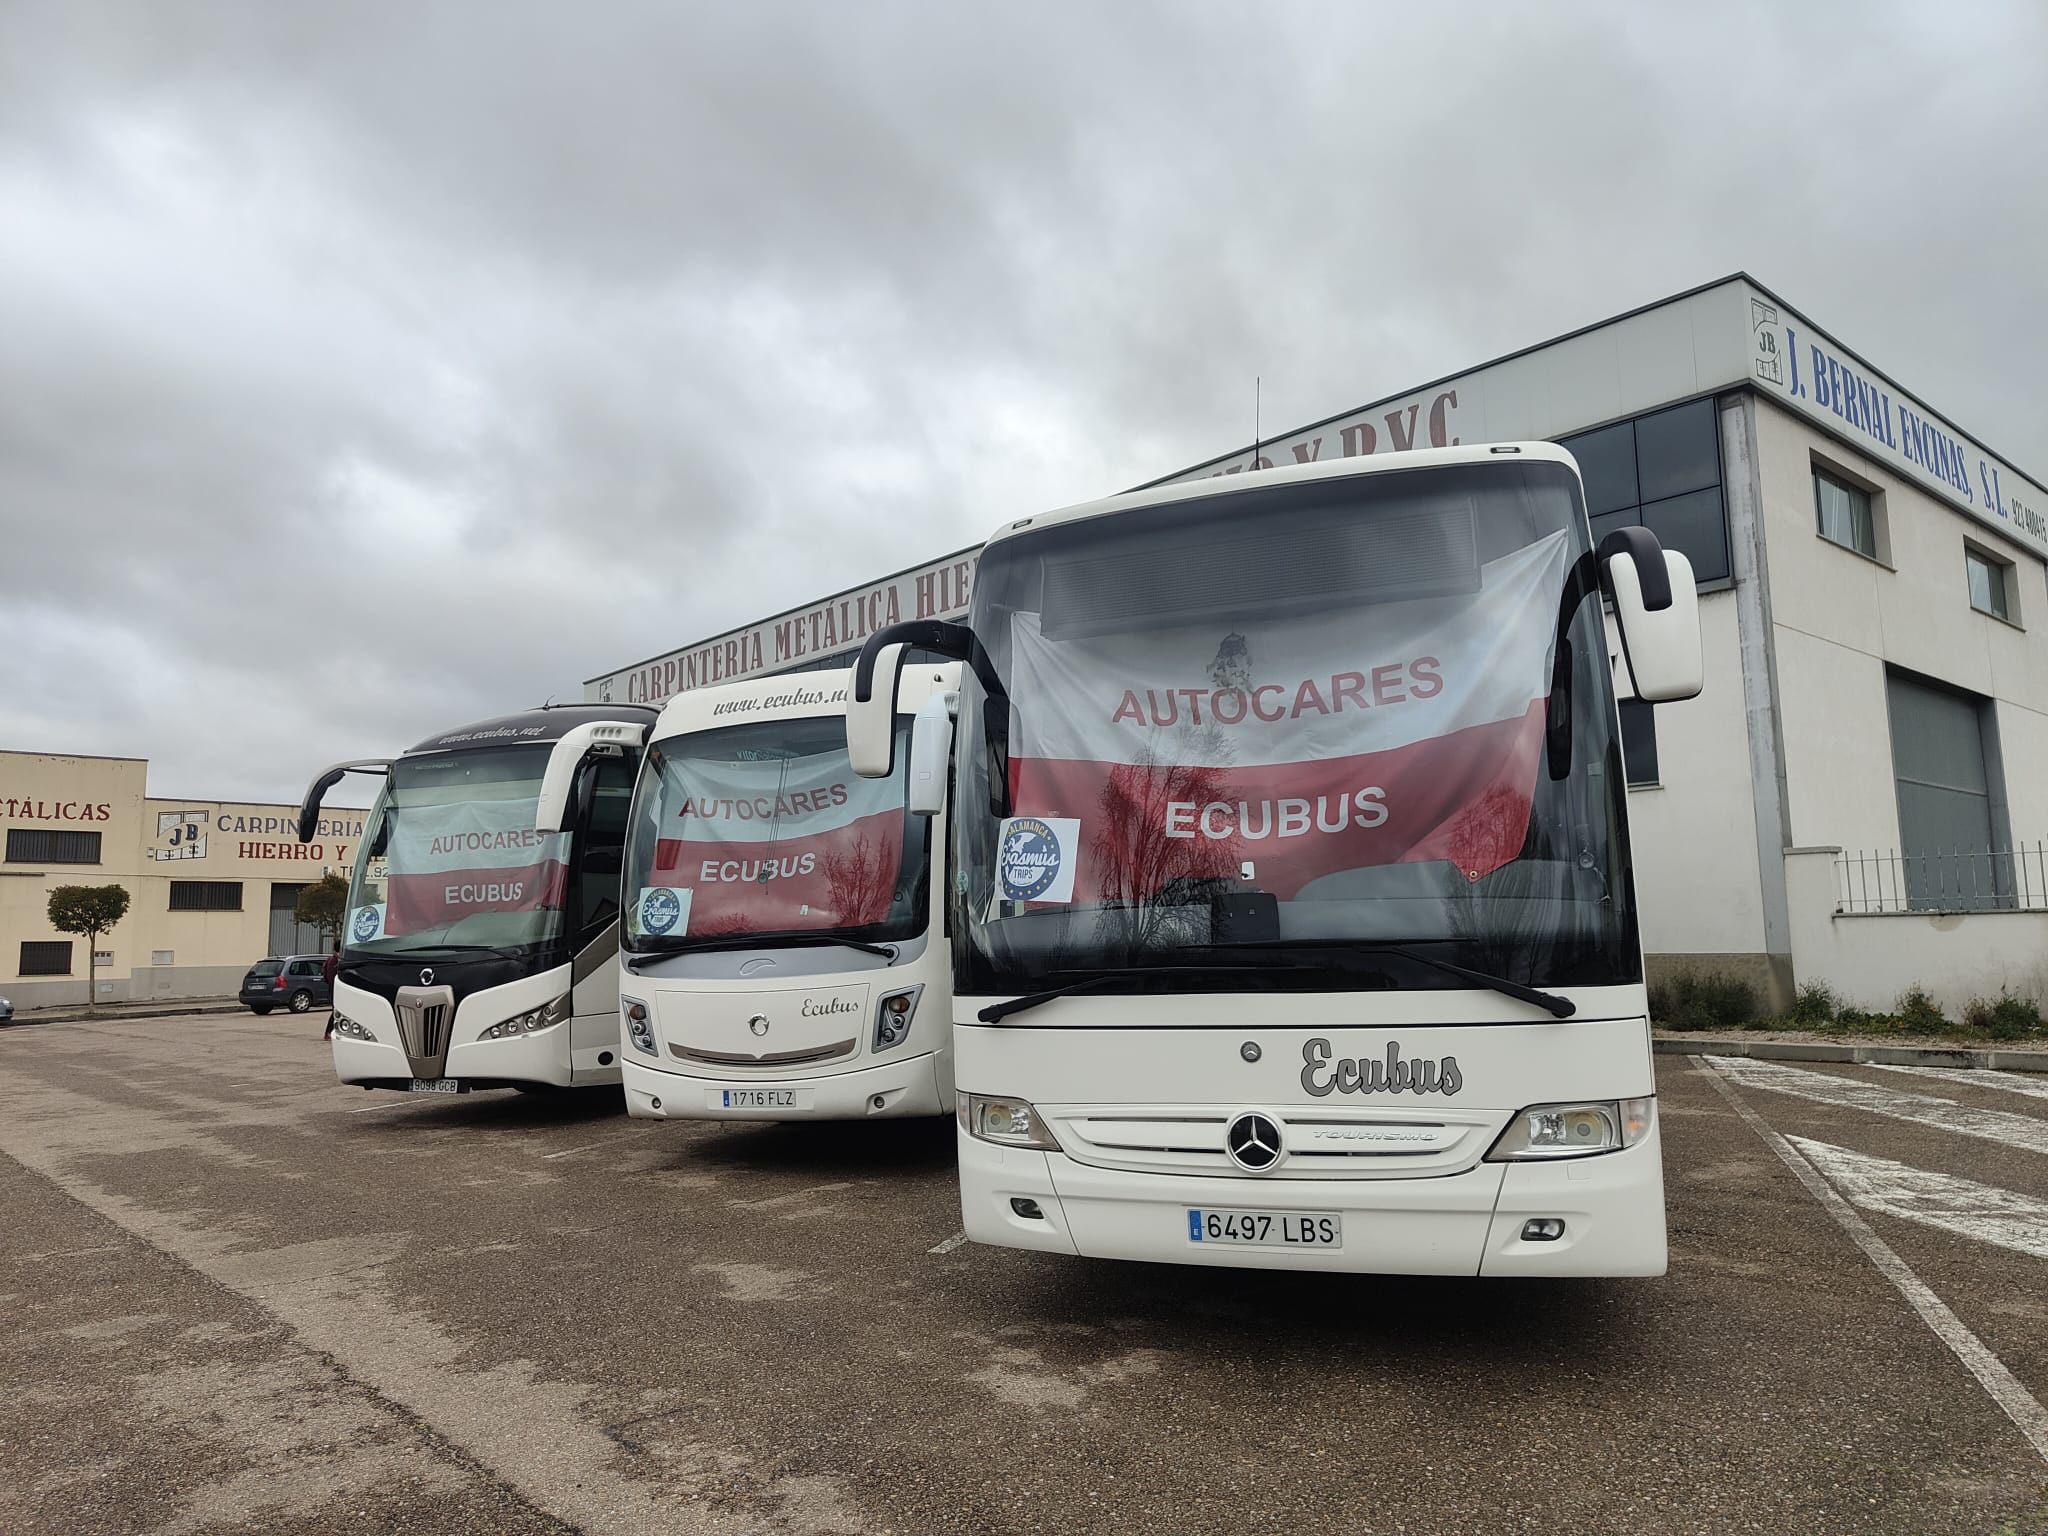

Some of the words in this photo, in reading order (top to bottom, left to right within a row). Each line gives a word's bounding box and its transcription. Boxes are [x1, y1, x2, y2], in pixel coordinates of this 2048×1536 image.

[1759, 331, 1776, 354] JB
[1786, 327, 1806, 399] J.
[1810, 344, 1897, 451] BERNAL
[1898, 404, 1974, 504] ENCINAS,
[1979, 460, 2008, 519] S.L.
[628, 629, 763, 703] CARPINTERÍA
[774, 585, 901, 663] METÁLICA
[915, 557, 979, 620] HIE
[1111, 656, 1444, 727] AUTOCARES
[0, 796, 111, 821] TÁLICAS
[678, 783, 848, 820] AUTOCARES
[1165, 786, 1390, 840] ECUBUS
[217, 814, 363, 838] CARPINERÍA
[1008, 821, 1049, 838] SALAMANCA
[238, 842, 324, 861] HIERRO
[335, 845, 348, 861] Y
[700, 853, 816, 882] ECUBUS
[1014, 869, 1034, 879] TRIPS
[445, 882, 523, 905] ECUBUS
[801, 997, 858, 1017] Ecubus
[1300, 1038, 1463, 1097] Ecubus
[733, 1092, 764, 1105] 1716
[768, 1091, 793, 1105] FLZ
[1313, 1130, 1439, 1141] TOURISMO
[1207, 1214, 1272, 1241] 6497
[1283, 1217, 1335, 1244] LBS
